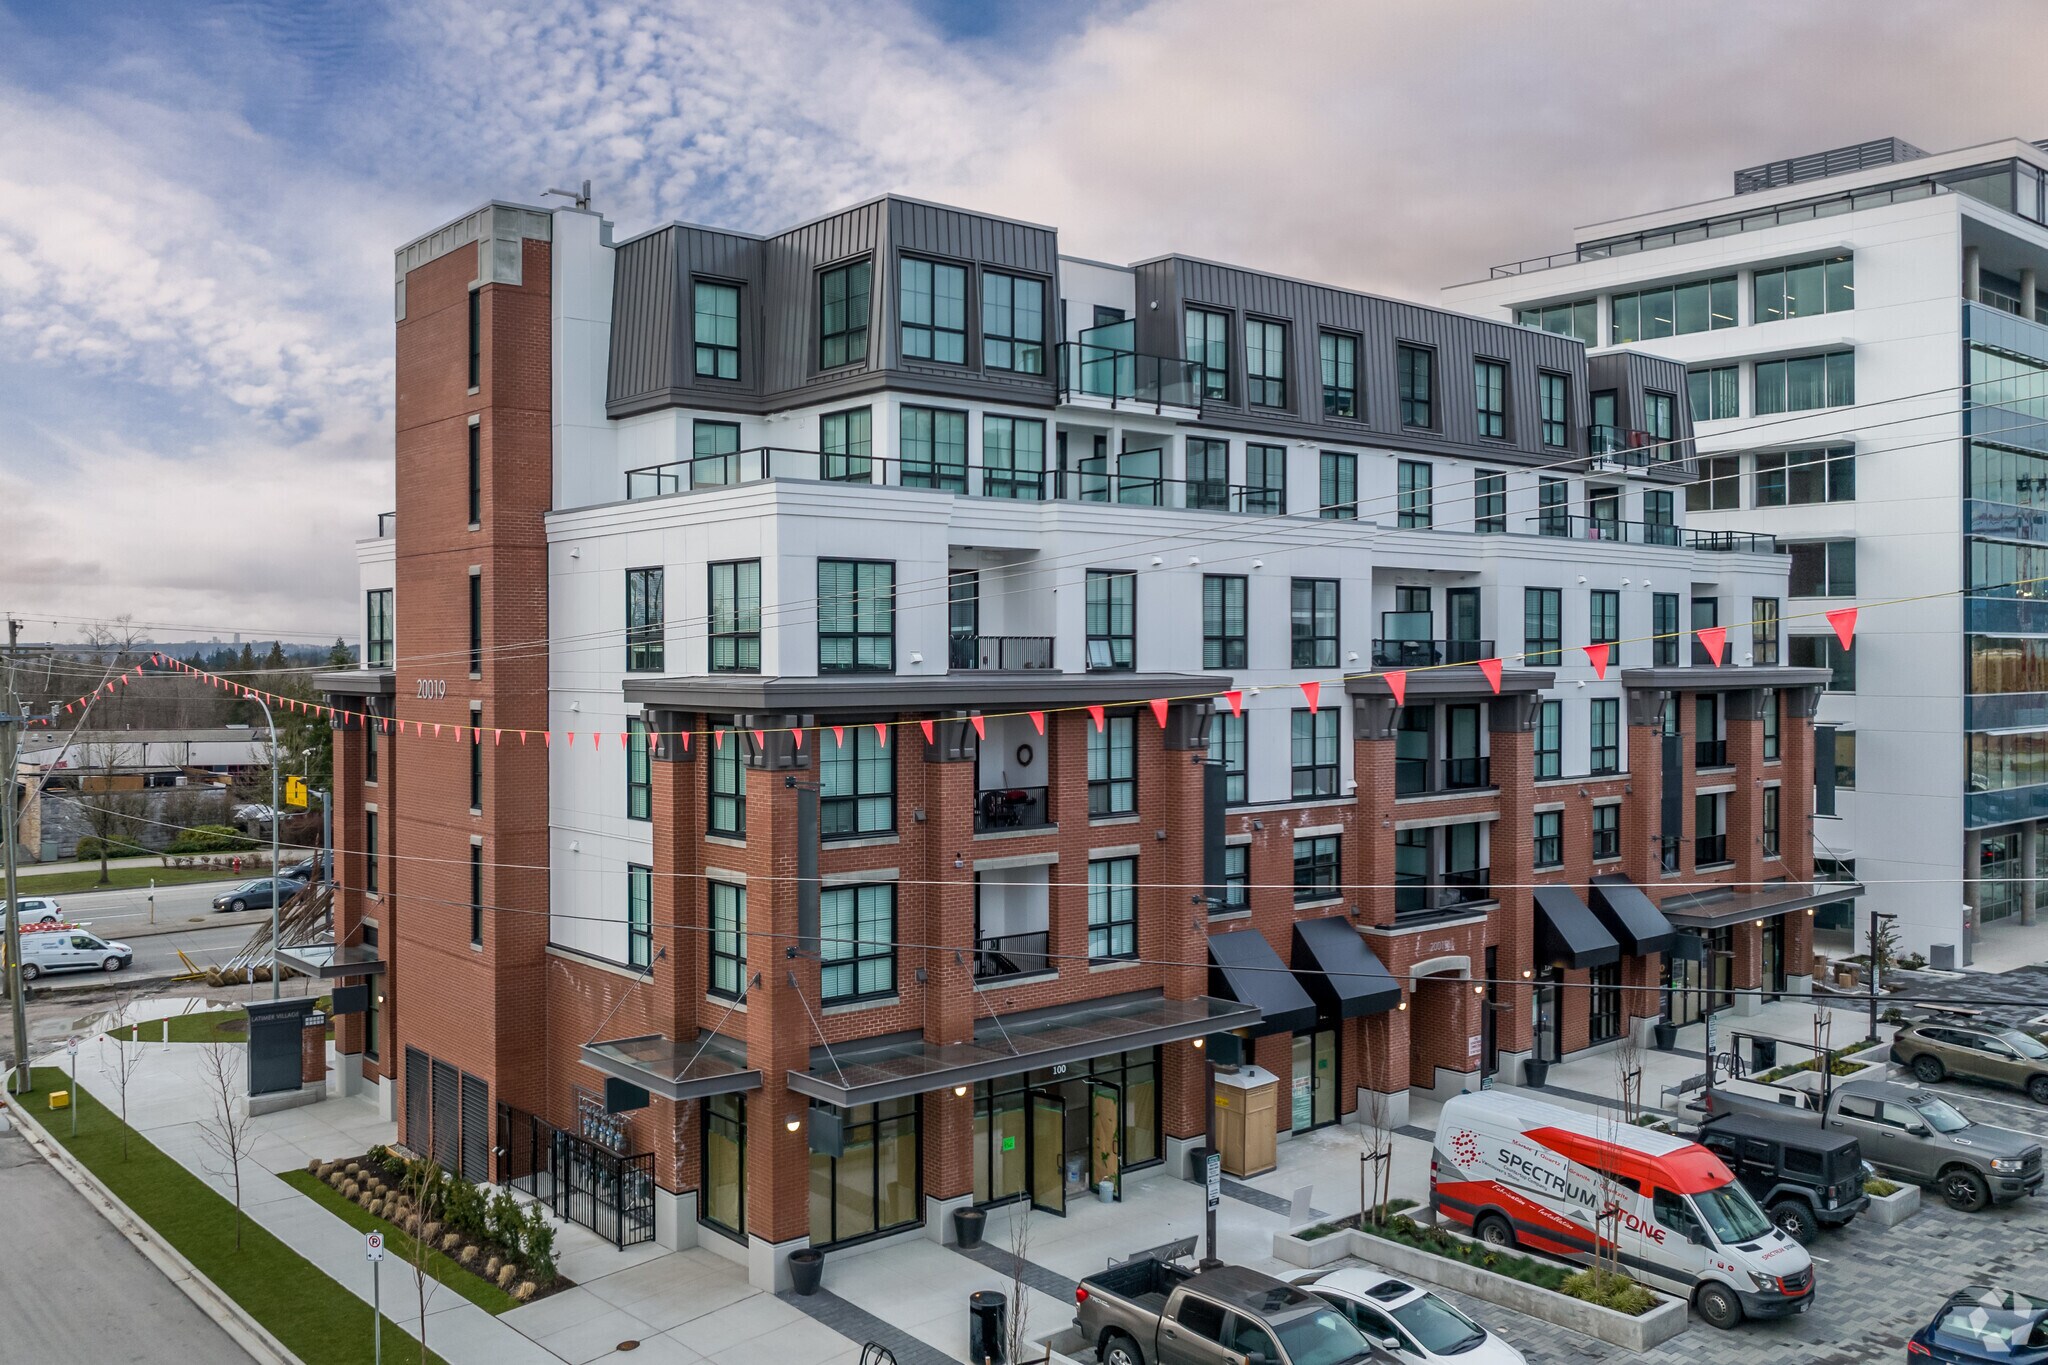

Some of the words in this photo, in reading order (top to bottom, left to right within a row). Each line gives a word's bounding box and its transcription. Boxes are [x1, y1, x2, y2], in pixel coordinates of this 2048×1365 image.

[416, 679, 446, 700] 20019
[251, 1014, 275, 1023] LATIMER
[275, 1011, 299, 1019] VILLAGE
[1052, 1064, 1067, 1075] 100
[1540, 1153, 1561, 1166] Quartz
[1568, 1168, 1591, 1182] Granite
[1491, 1184, 1526, 1205] Fabrication
[1538, 1208, 1574, 1230] Installation
[1498, 1148, 1597, 1208] SPECTRUM
[1602, 1200, 1667, 1245] STONE
[1761, 1247, 1785, 1261] SPECTRUM
